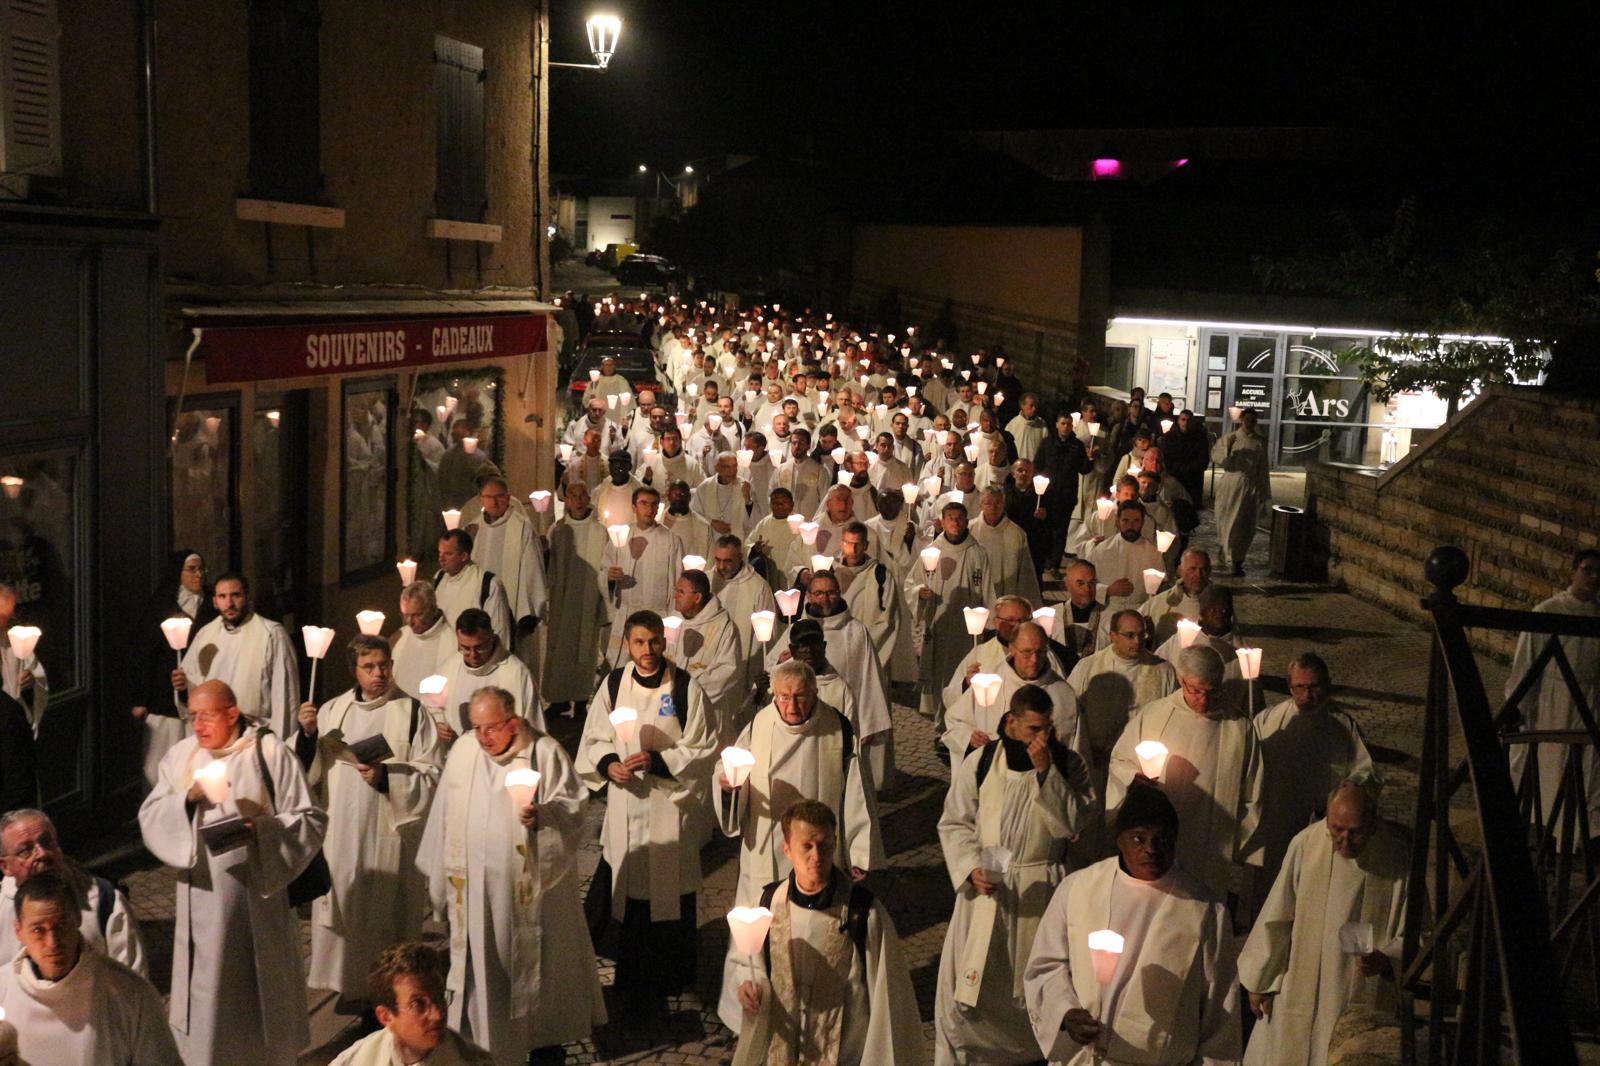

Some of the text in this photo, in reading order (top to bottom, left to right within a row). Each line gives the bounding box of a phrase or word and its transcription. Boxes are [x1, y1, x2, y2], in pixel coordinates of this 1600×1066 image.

[306, 330, 405, 368] SOUVENIRS
[432, 325, 493, 357] CADEAUX
[1242, 388, 1266, 396] ACCUEIL
[1299, 390, 1349, 418] Ars
